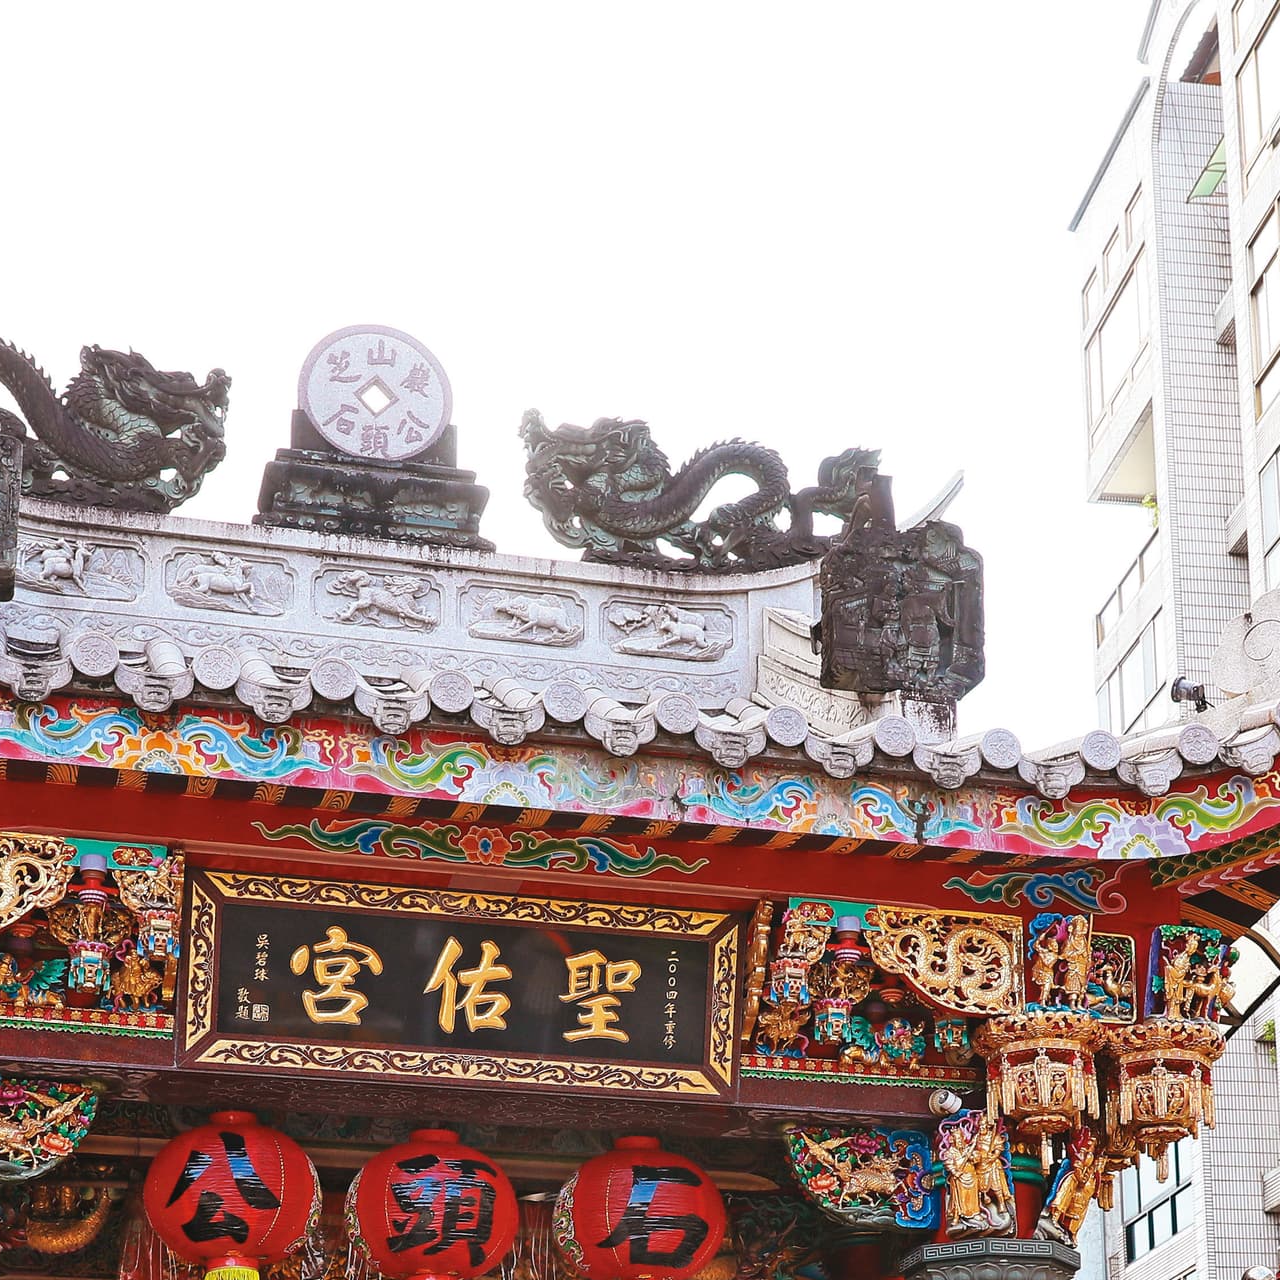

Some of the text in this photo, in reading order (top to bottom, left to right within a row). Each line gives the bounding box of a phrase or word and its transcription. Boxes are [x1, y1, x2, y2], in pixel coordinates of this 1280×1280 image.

[322, 403, 430, 457] 石頭公
[288, 925, 643, 1046] 聖佑宮
[167, 1131, 281, 1244] 公
[387, 1154, 498, 1268] 頭
[597, 1163, 710, 1269] 石
